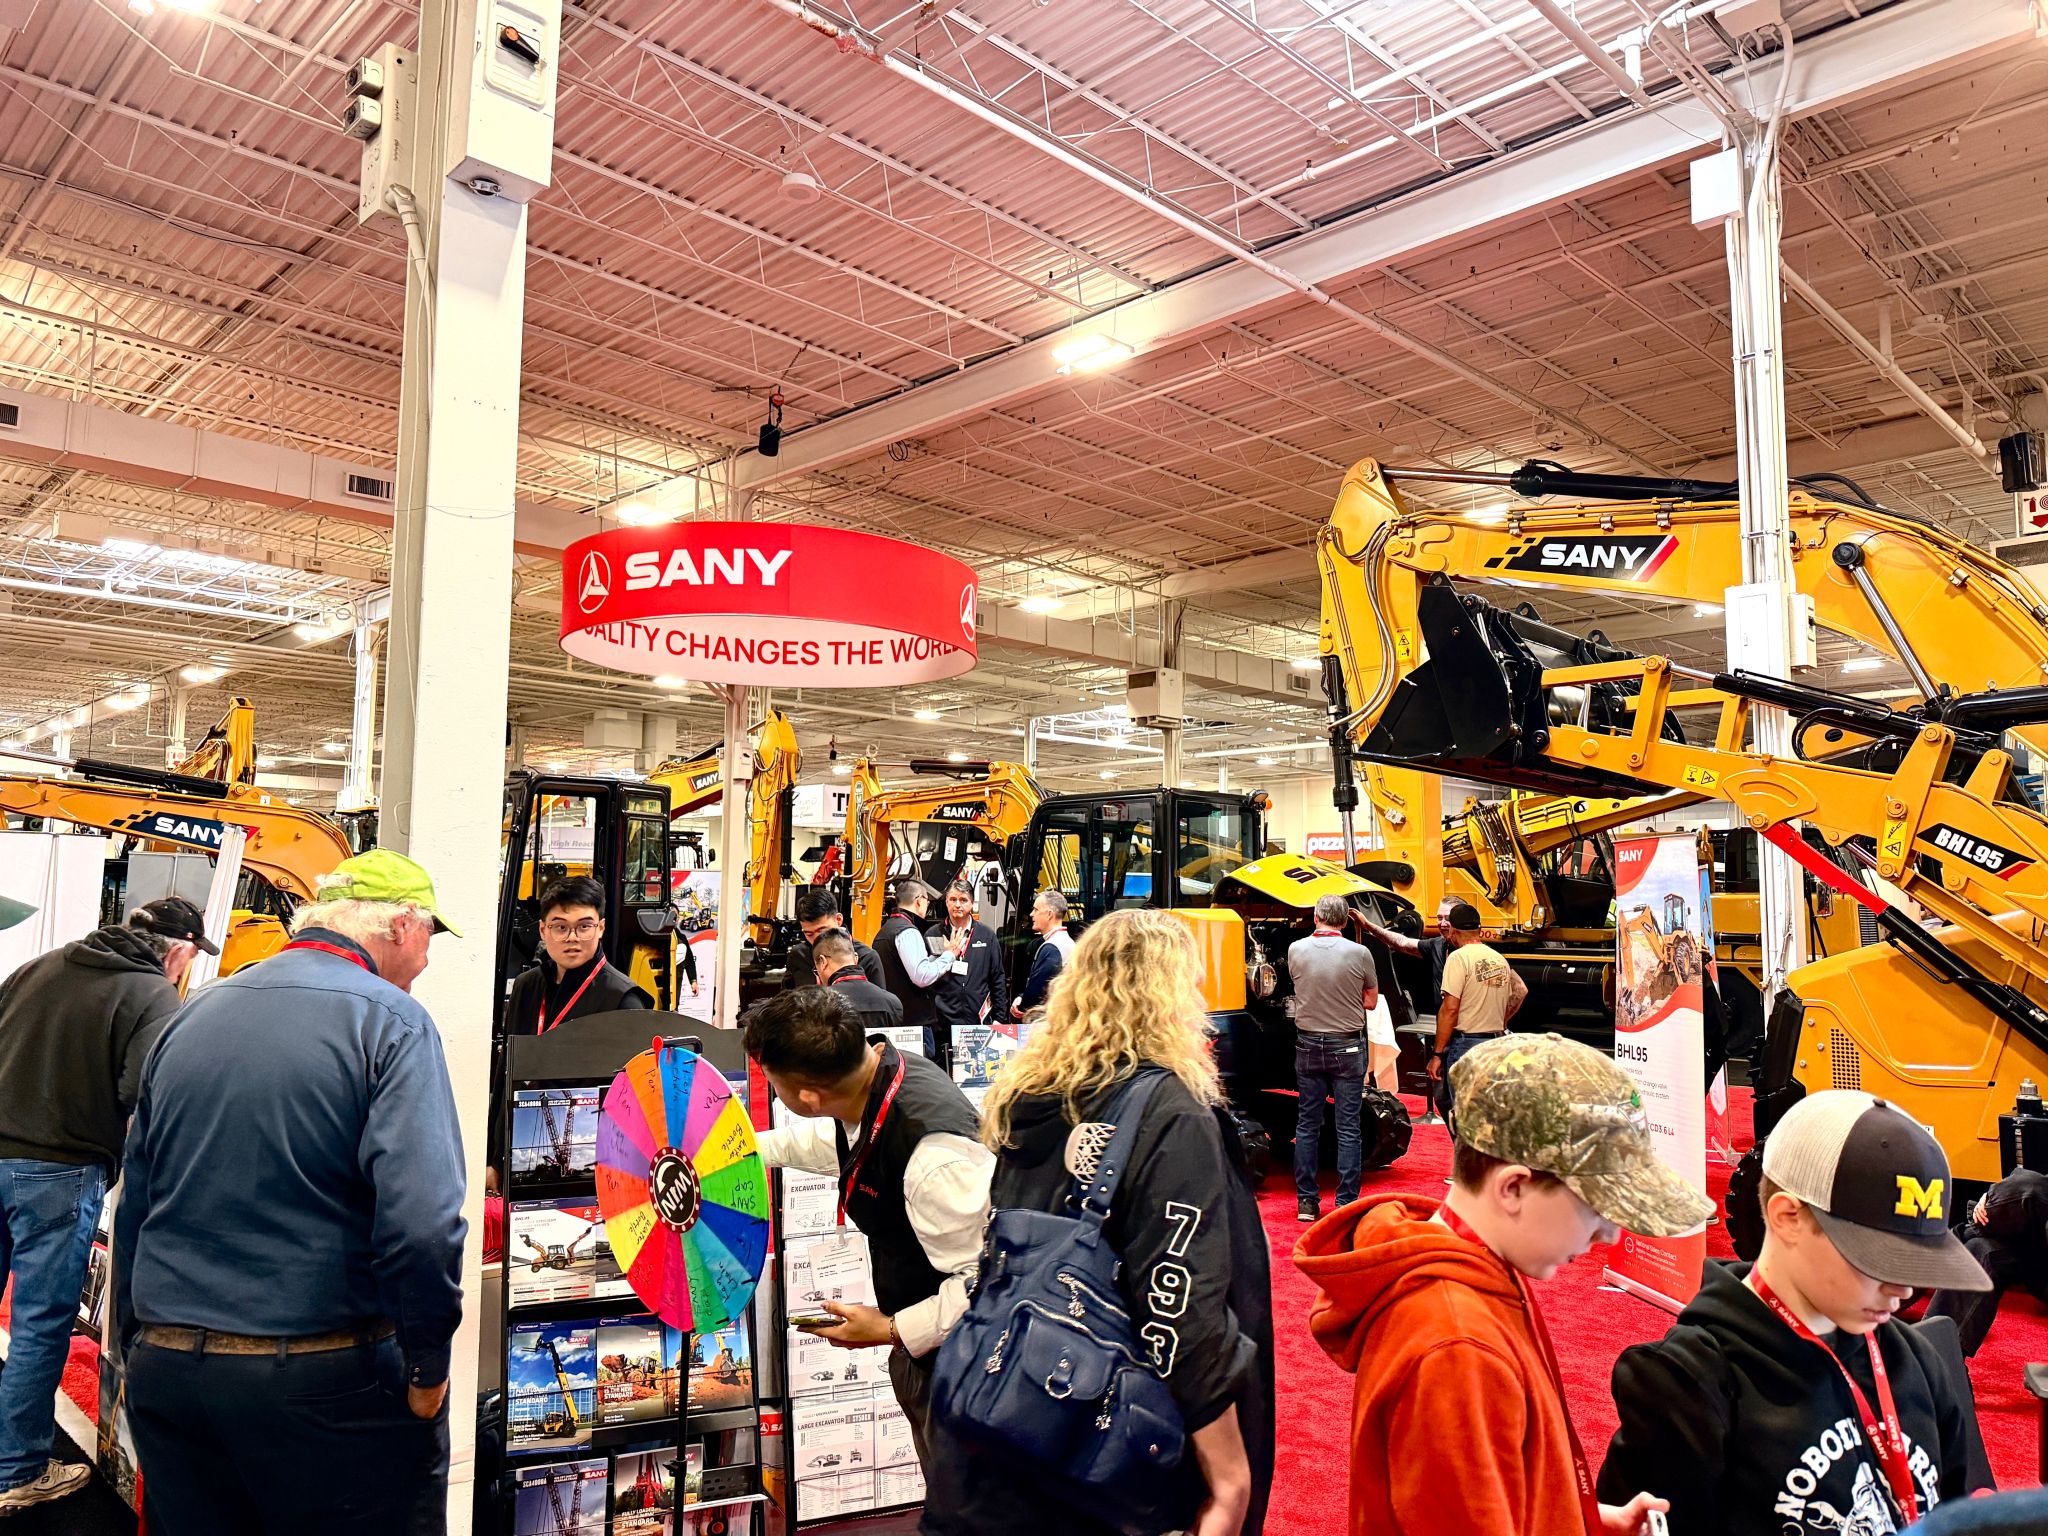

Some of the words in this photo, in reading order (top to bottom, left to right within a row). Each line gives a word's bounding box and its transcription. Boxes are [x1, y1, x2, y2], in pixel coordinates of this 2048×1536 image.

[1540, 543, 1647, 569] SANY
[625, 547, 794, 591] SANY
[584, 621, 660, 652] ALITY
[665, 631, 820, 666] CHANGES
[827, 640, 883, 664] THE
[890, 635, 960, 663] WORL
[696, 772, 719, 789] SANY
[943, 806, 973, 818] SANY
[154, 816, 224, 845] SANY
[1618, 849, 1643, 863] SANY
[1934, 827, 2005, 870] BHL95
[1617, 1043, 1648, 1062] BHL95
[790, 1183, 826, 1193] EXCAVATOR
[1894, 1175, 1945, 1220] M
[730, 1189, 756, 1210] SANY
[793, 1261, 811, 1270] EXCA
[1141, 1201, 1203, 1380] 793
[1778, 1306, 1800, 1328] SANY
[799, 1337, 828, 1347] EXCAVAT
[1870, 1340, 1882, 1367] SANY
[604, 1391, 634, 1399] STANDARD
[797, 1423, 815, 1431] LARGE
[815, 1417, 845, 1428] EXCAVATOR
[878, 1410, 905, 1421] BACKHOE
[1887, 1413, 1900, 1441] SANY
[1872, 1434, 1889, 1461] SANY
[584, 1470, 608, 1479] SANY
[1578, 1469, 1590, 1496] SANY
[621, 1518, 655, 1529] STANDARD
